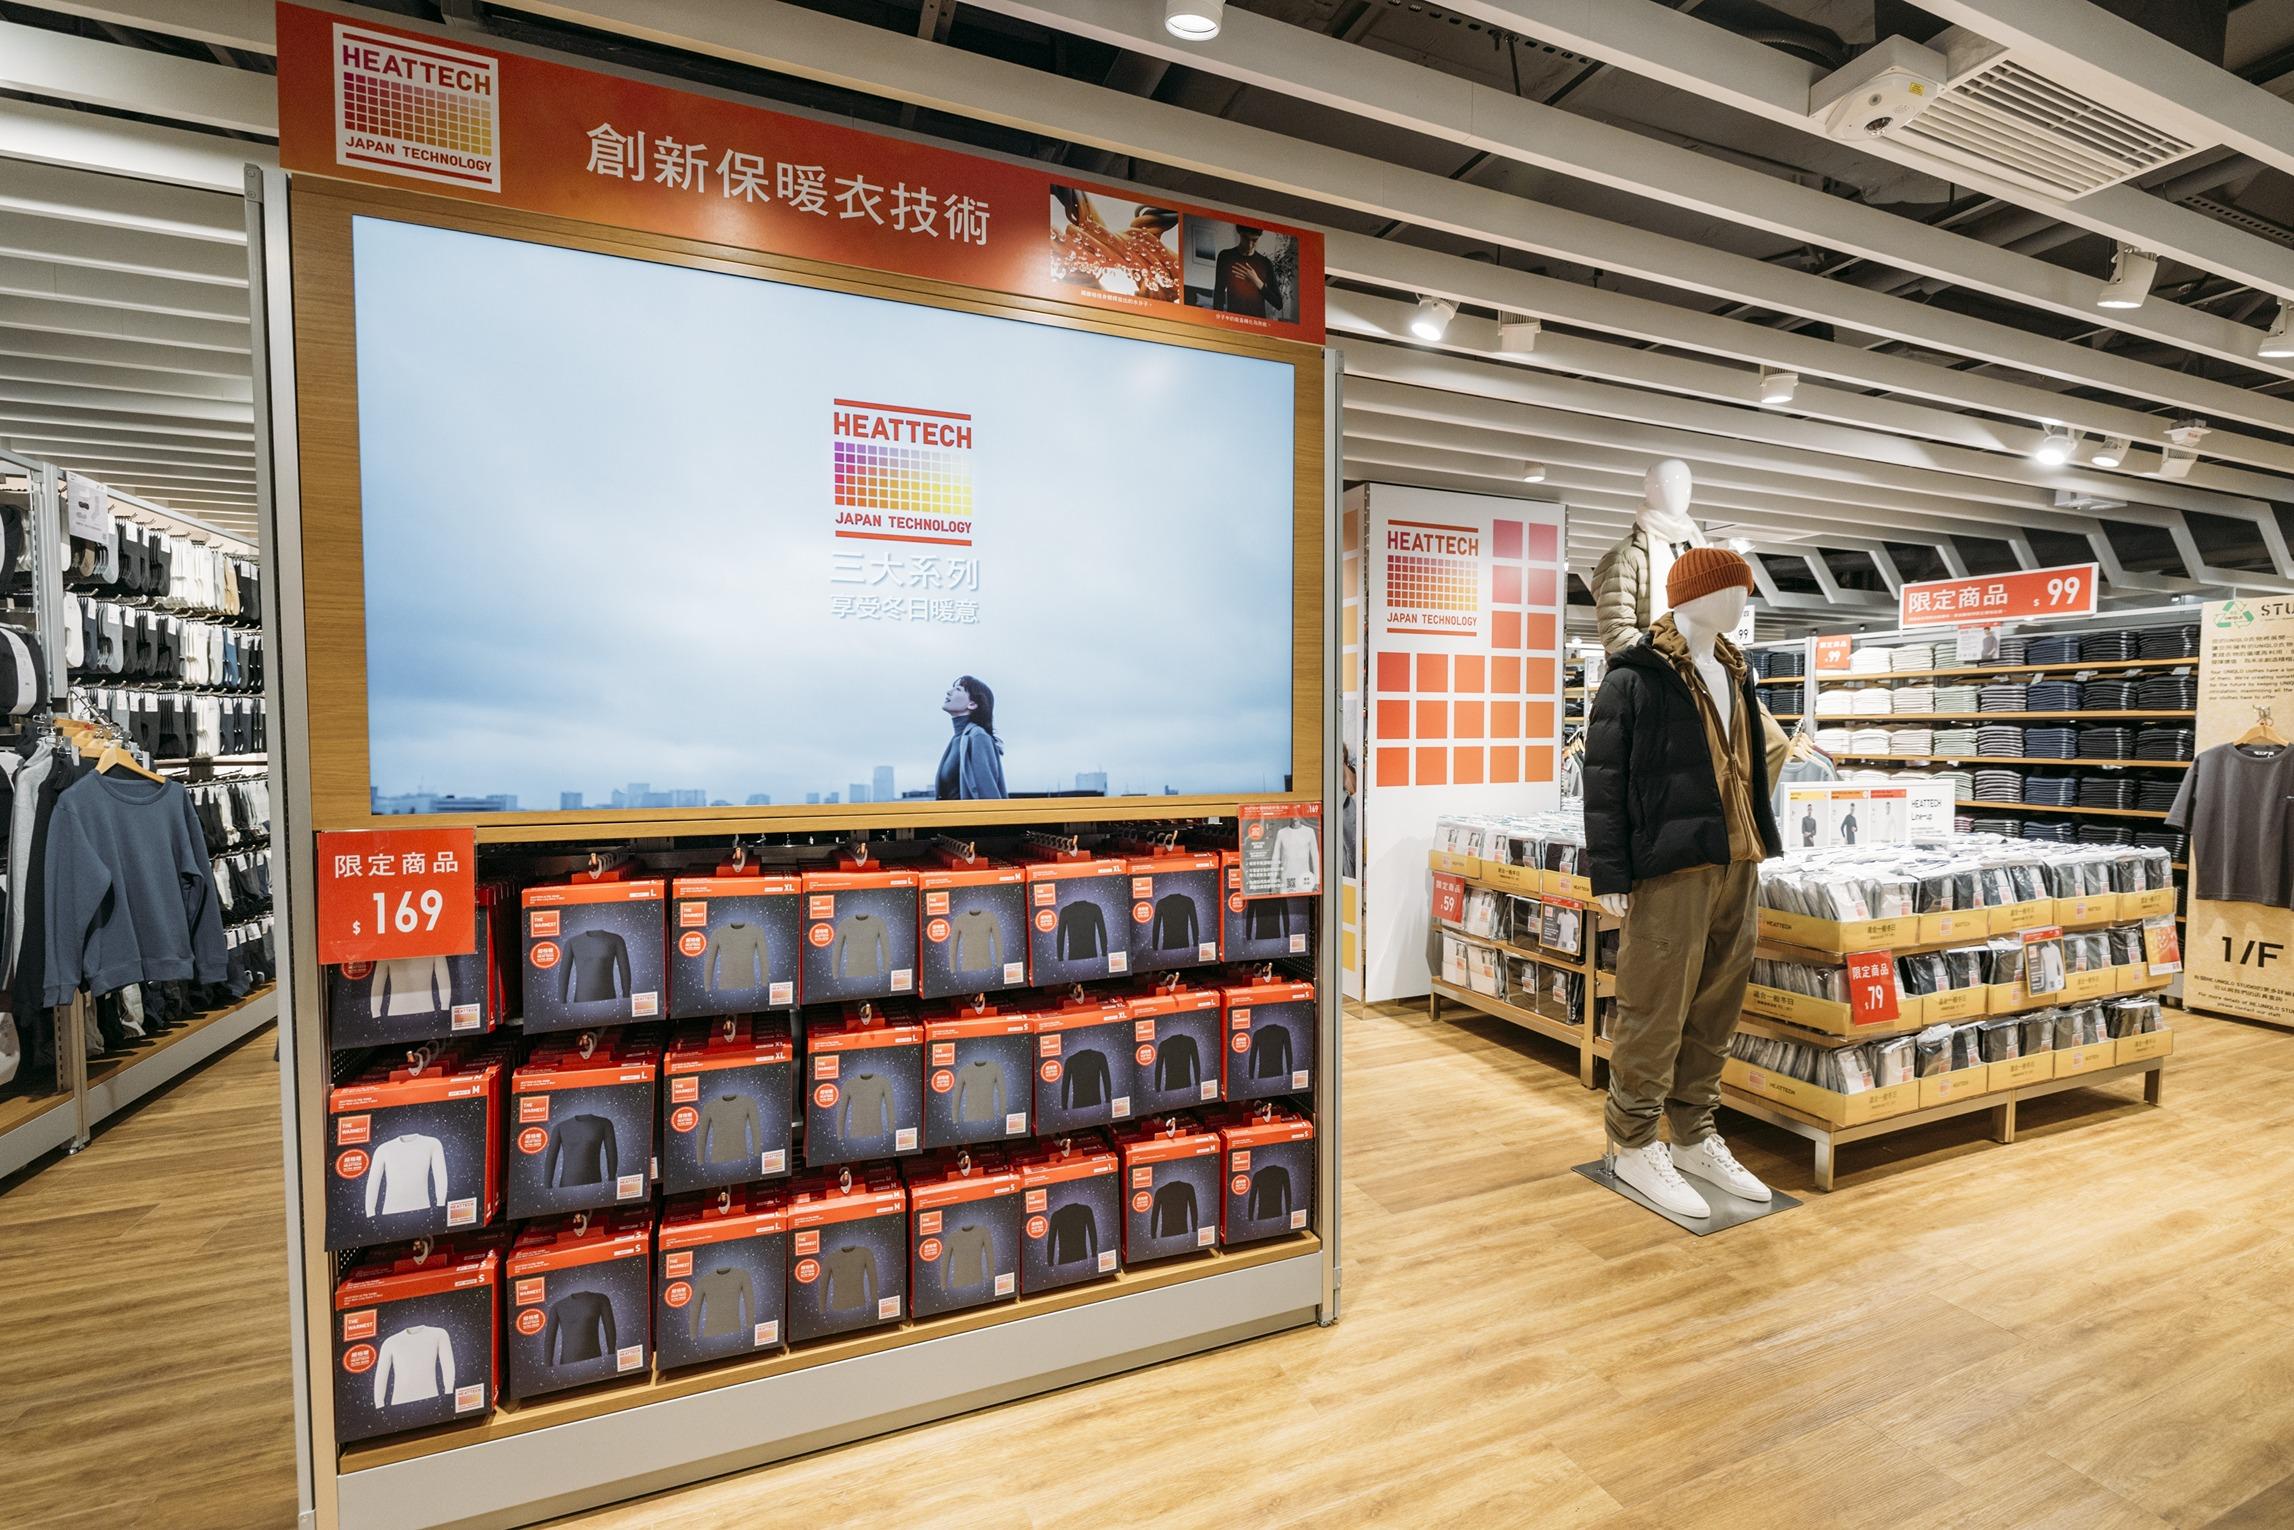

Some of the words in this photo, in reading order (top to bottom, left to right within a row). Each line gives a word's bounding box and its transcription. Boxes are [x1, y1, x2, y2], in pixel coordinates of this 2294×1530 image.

[342, 44, 491, 96] HEATTECH
[345, 136, 396, 155] JAPAN
[402, 146, 493, 174] TECHNOLOGY
[586, 123, 990, 246] 創新保暖衣技術
[834, 411, 972, 449] HEATTECH
[835, 512, 882, 527] JAPAN
[888, 516, 972, 533] TECHNOLOGY
[1387, 530, 1479, 556] HEATTECH
[830, 551, 980, 591] 三大系列
[1908, 584, 2008, 613] 限定商品
[830, 595, 980, 624] 享受冬日暖意
[1387, 612, 1418, 624] JAPAN
[1422, 614, 1477, 626] TECHNOLOGY
[334, 851, 458, 879] 限定商品
[651, 889, 657, 897] L
[784, 884, 795, 892] XL
[2221, 936, 2284, 968] 1/F
[1851, 963, 1889, 980] 限定商品
[912, 1034, 918, 1042] L
[775, 1051, 786, 1060] XL
[641, 1071, 647, 1080] L
[472, 1085, 480, 1094] M
[774, 1222, 780, 1230] L
[635, 1244, 641, 1252] S
[478, 1274, 485, 1282] S
